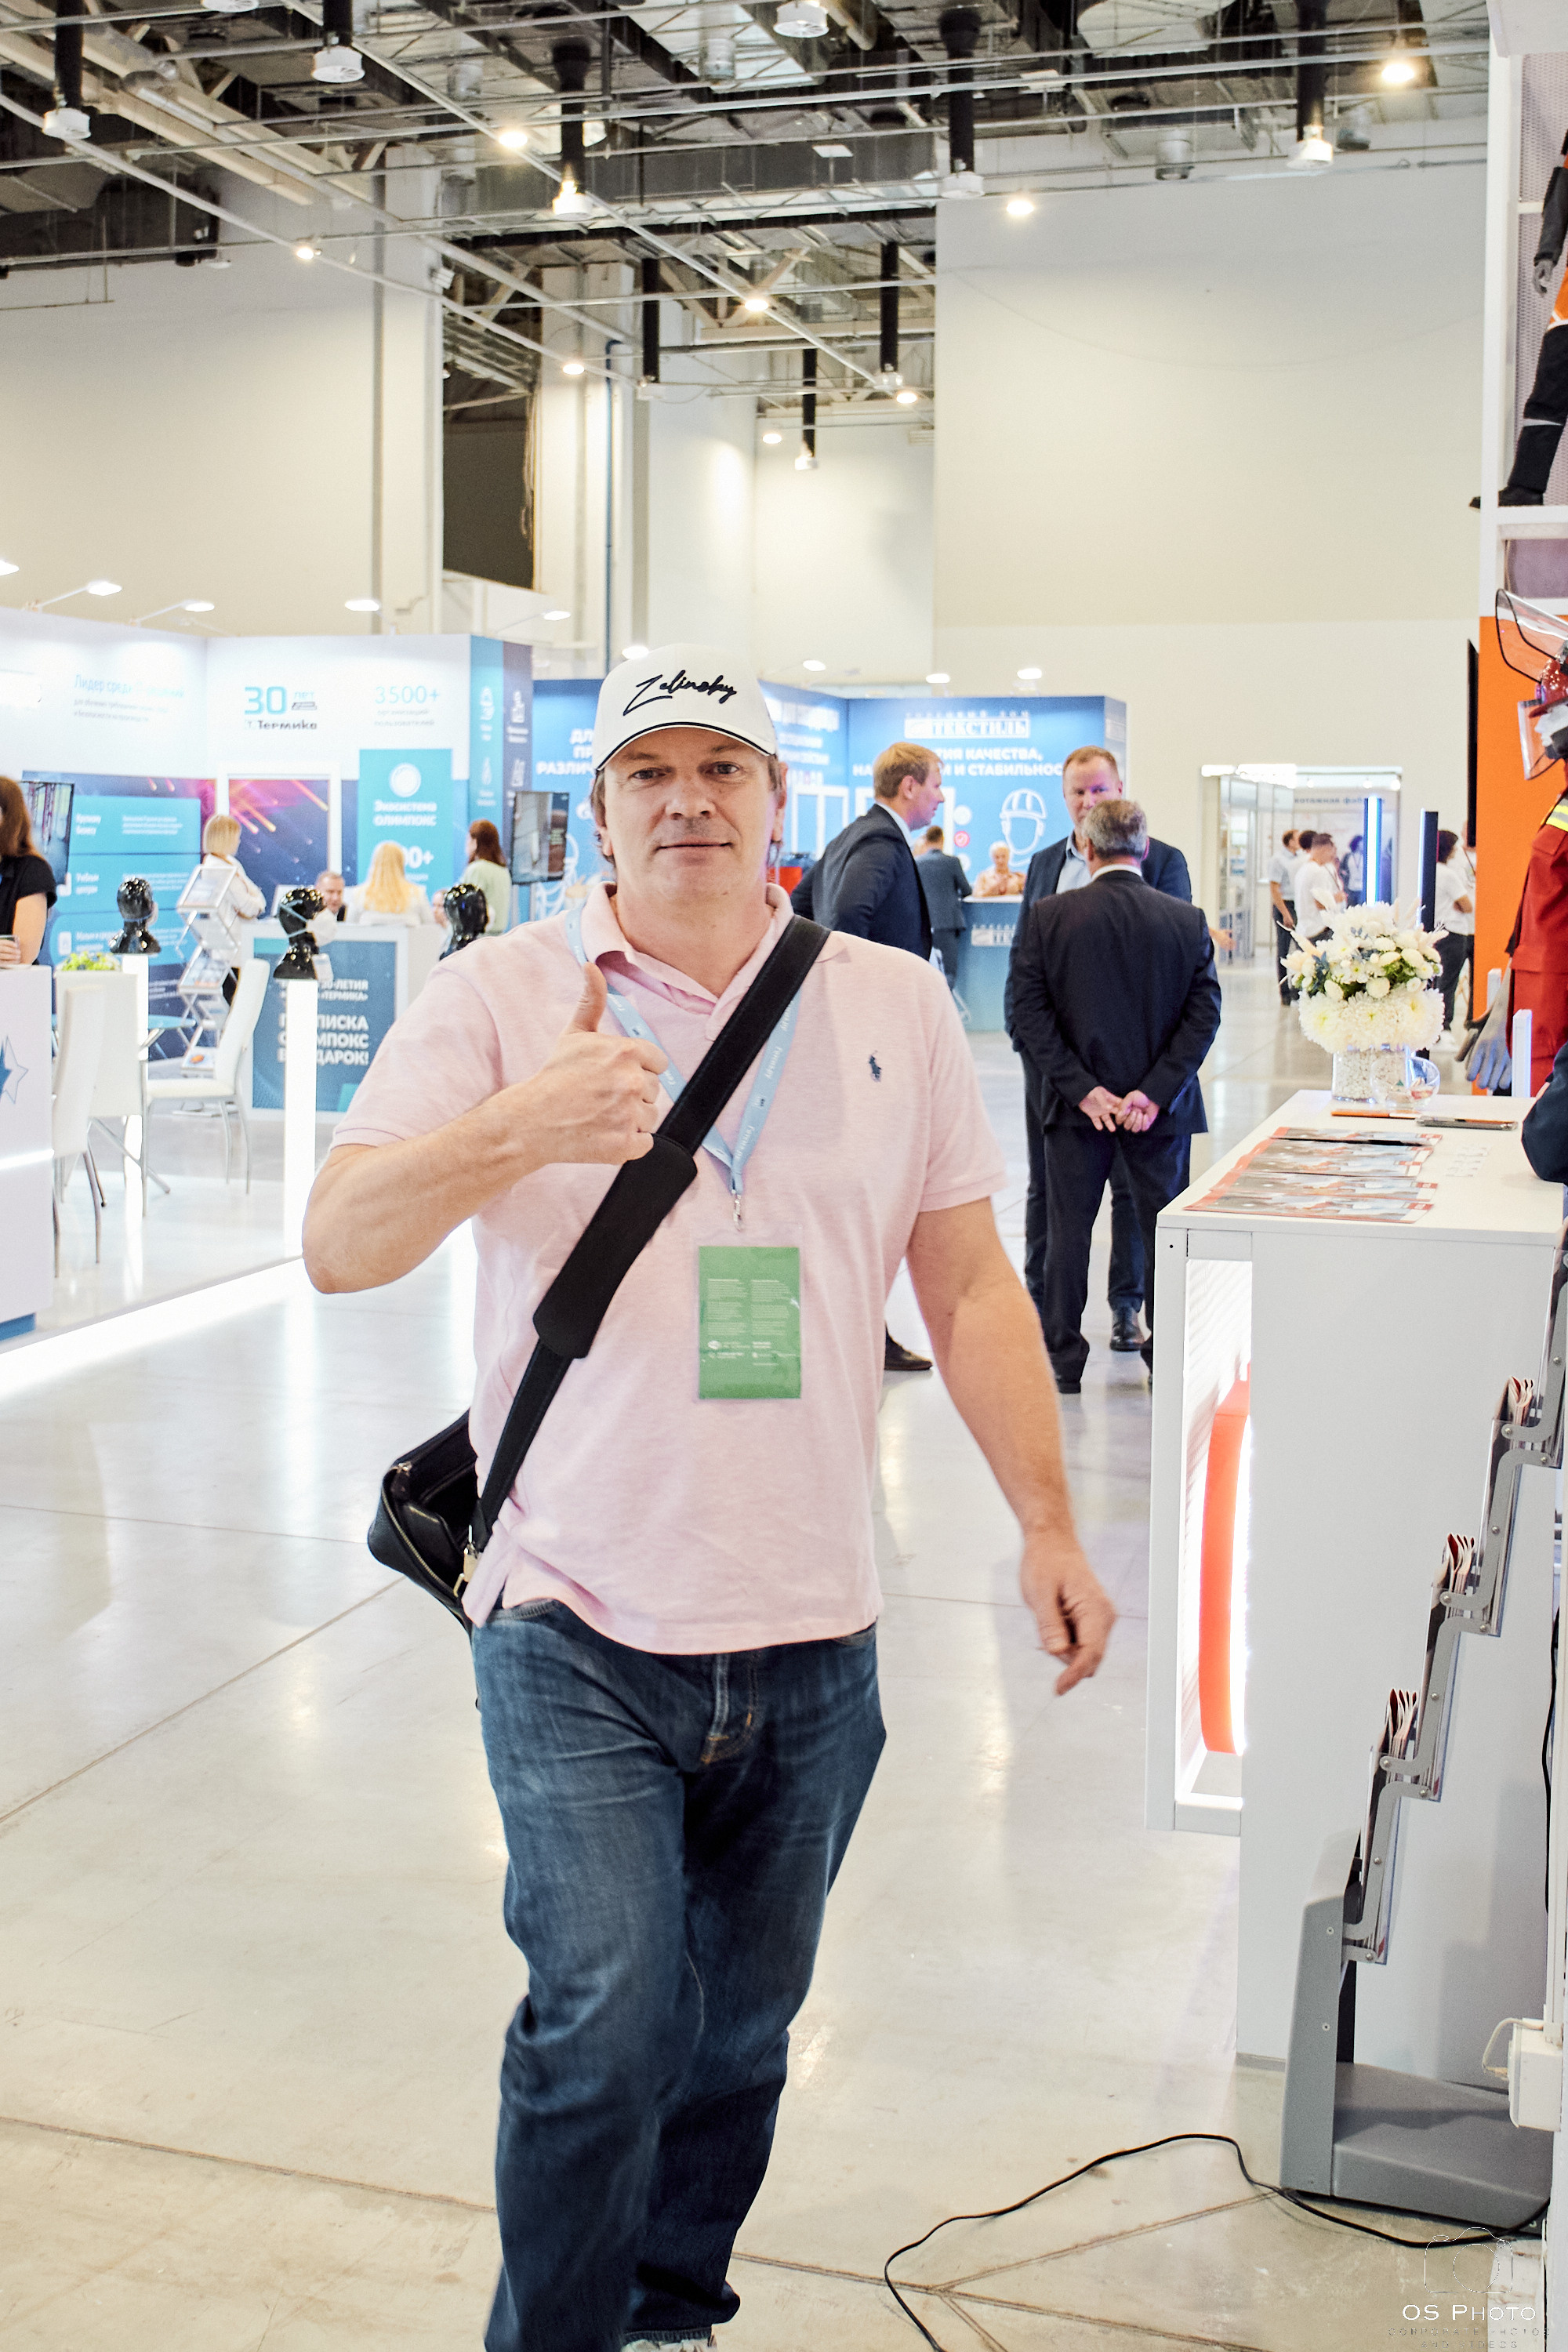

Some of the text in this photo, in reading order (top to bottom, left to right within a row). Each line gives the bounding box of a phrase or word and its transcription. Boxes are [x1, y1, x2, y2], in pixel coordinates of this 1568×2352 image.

[244, 686, 287, 715] 30
[374, 684, 440, 705] 3500+
[258, 720, 318, 730] Термика
[933, 720, 1026, 735] ТЕКСТИЛЬ
[965, 748, 1043, 761] КАЧЕСТВА,
[967, 764, 1063, 776] СТАБИЛЬНОС
[317, 1048, 369, 1066] ДАРОК!
